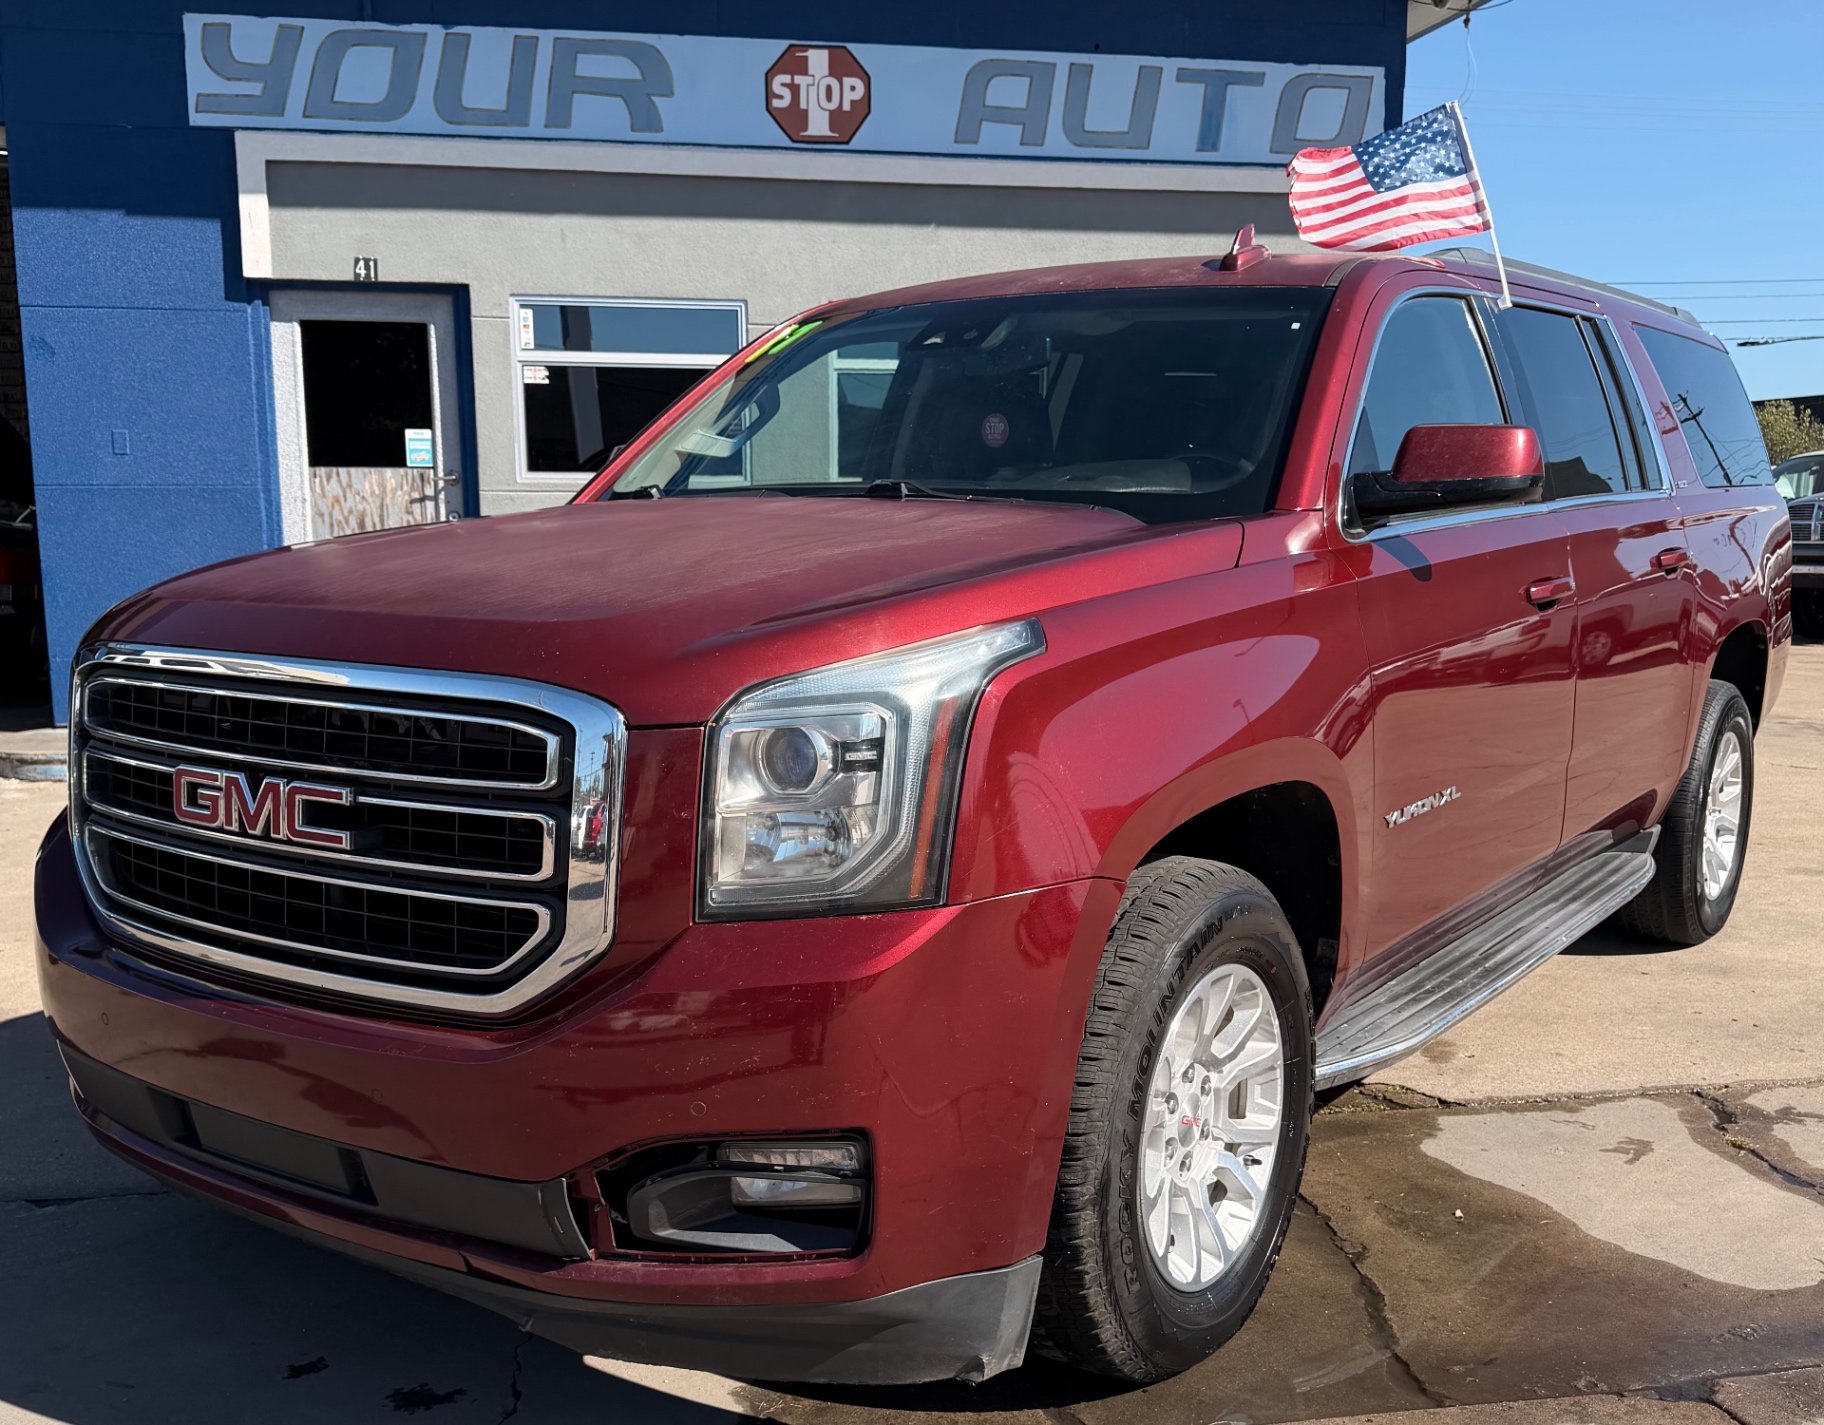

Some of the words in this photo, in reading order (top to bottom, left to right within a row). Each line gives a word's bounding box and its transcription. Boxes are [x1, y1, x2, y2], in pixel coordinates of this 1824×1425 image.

[195, 22, 675, 133] YOUR
[771, 74, 865, 112] STOP
[954, 58, 1375, 156] AUTO
[355, 258, 376, 280] 41
[985, 422, 1005, 434] STOP
[844, 750, 878, 761] GMC
[173, 763, 352, 850] GMC
[1383, 792, 1440, 829] YUKON
[1439, 785, 1462, 806] XL
[1126, 914, 1224, 1122] MOUNTAIN
[1118, 1128, 1142, 1296] ROCKY
